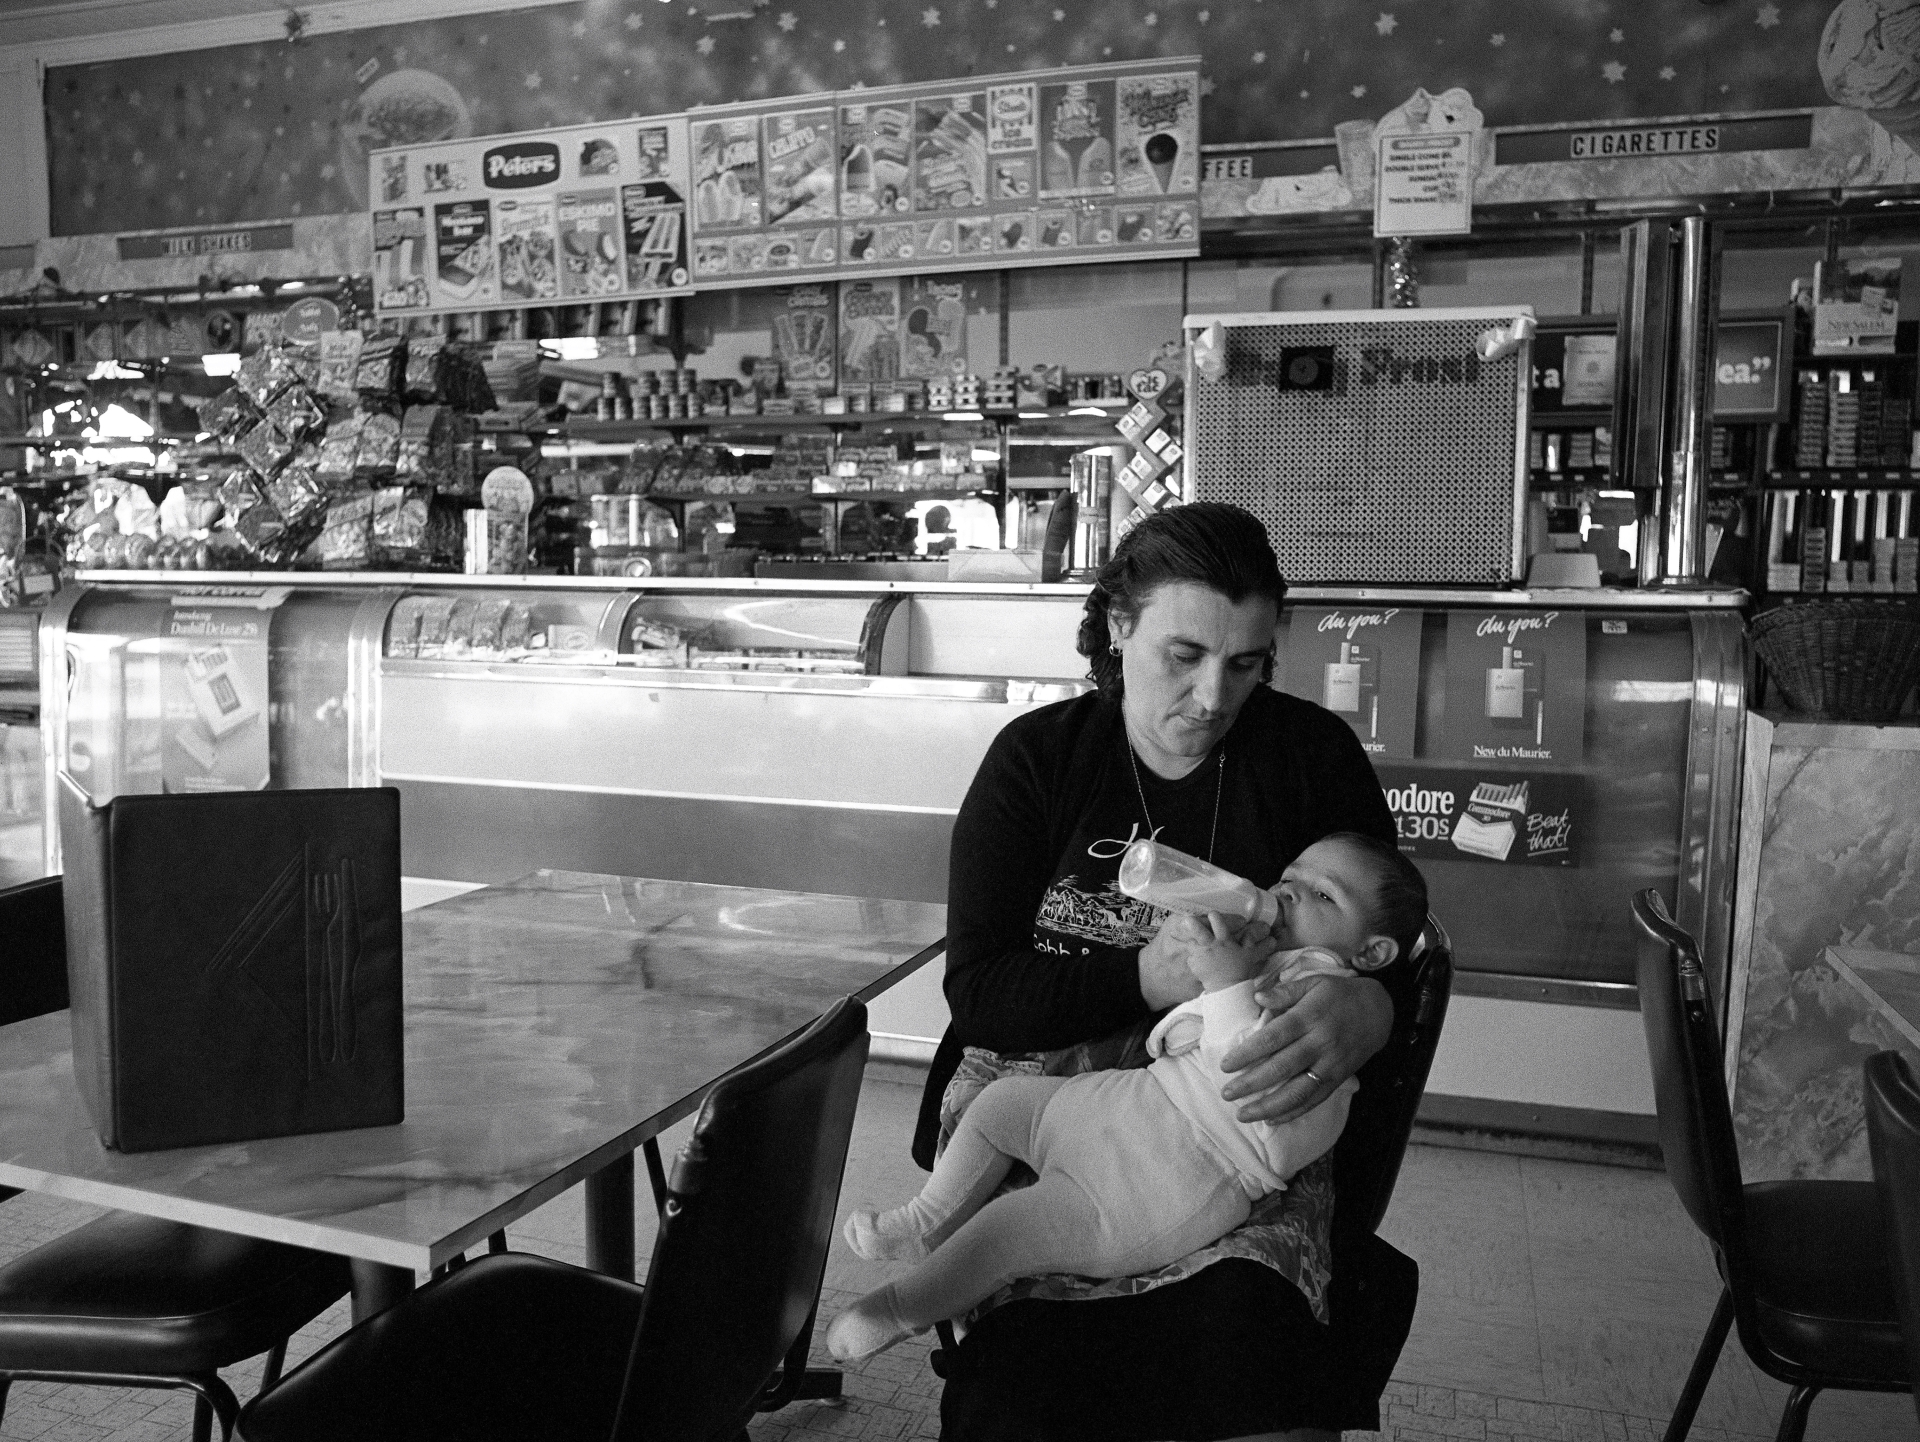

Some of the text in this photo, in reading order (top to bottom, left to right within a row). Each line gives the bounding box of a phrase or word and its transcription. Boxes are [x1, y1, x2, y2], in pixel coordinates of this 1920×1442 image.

[1573, 128, 1717, 156] CIGARETTES
[487, 154, 556, 178] Peters
[1317, 608, 1400, 640] du you?
[1476, 611, 1559, 644] du you?
[1473, 745, 1552, 759] New du Maurier.
[1381, 783, 1455, 815] odore
[1526, 807, 1570, 832] Beat
[1526, 824, 1572, 852] that!
